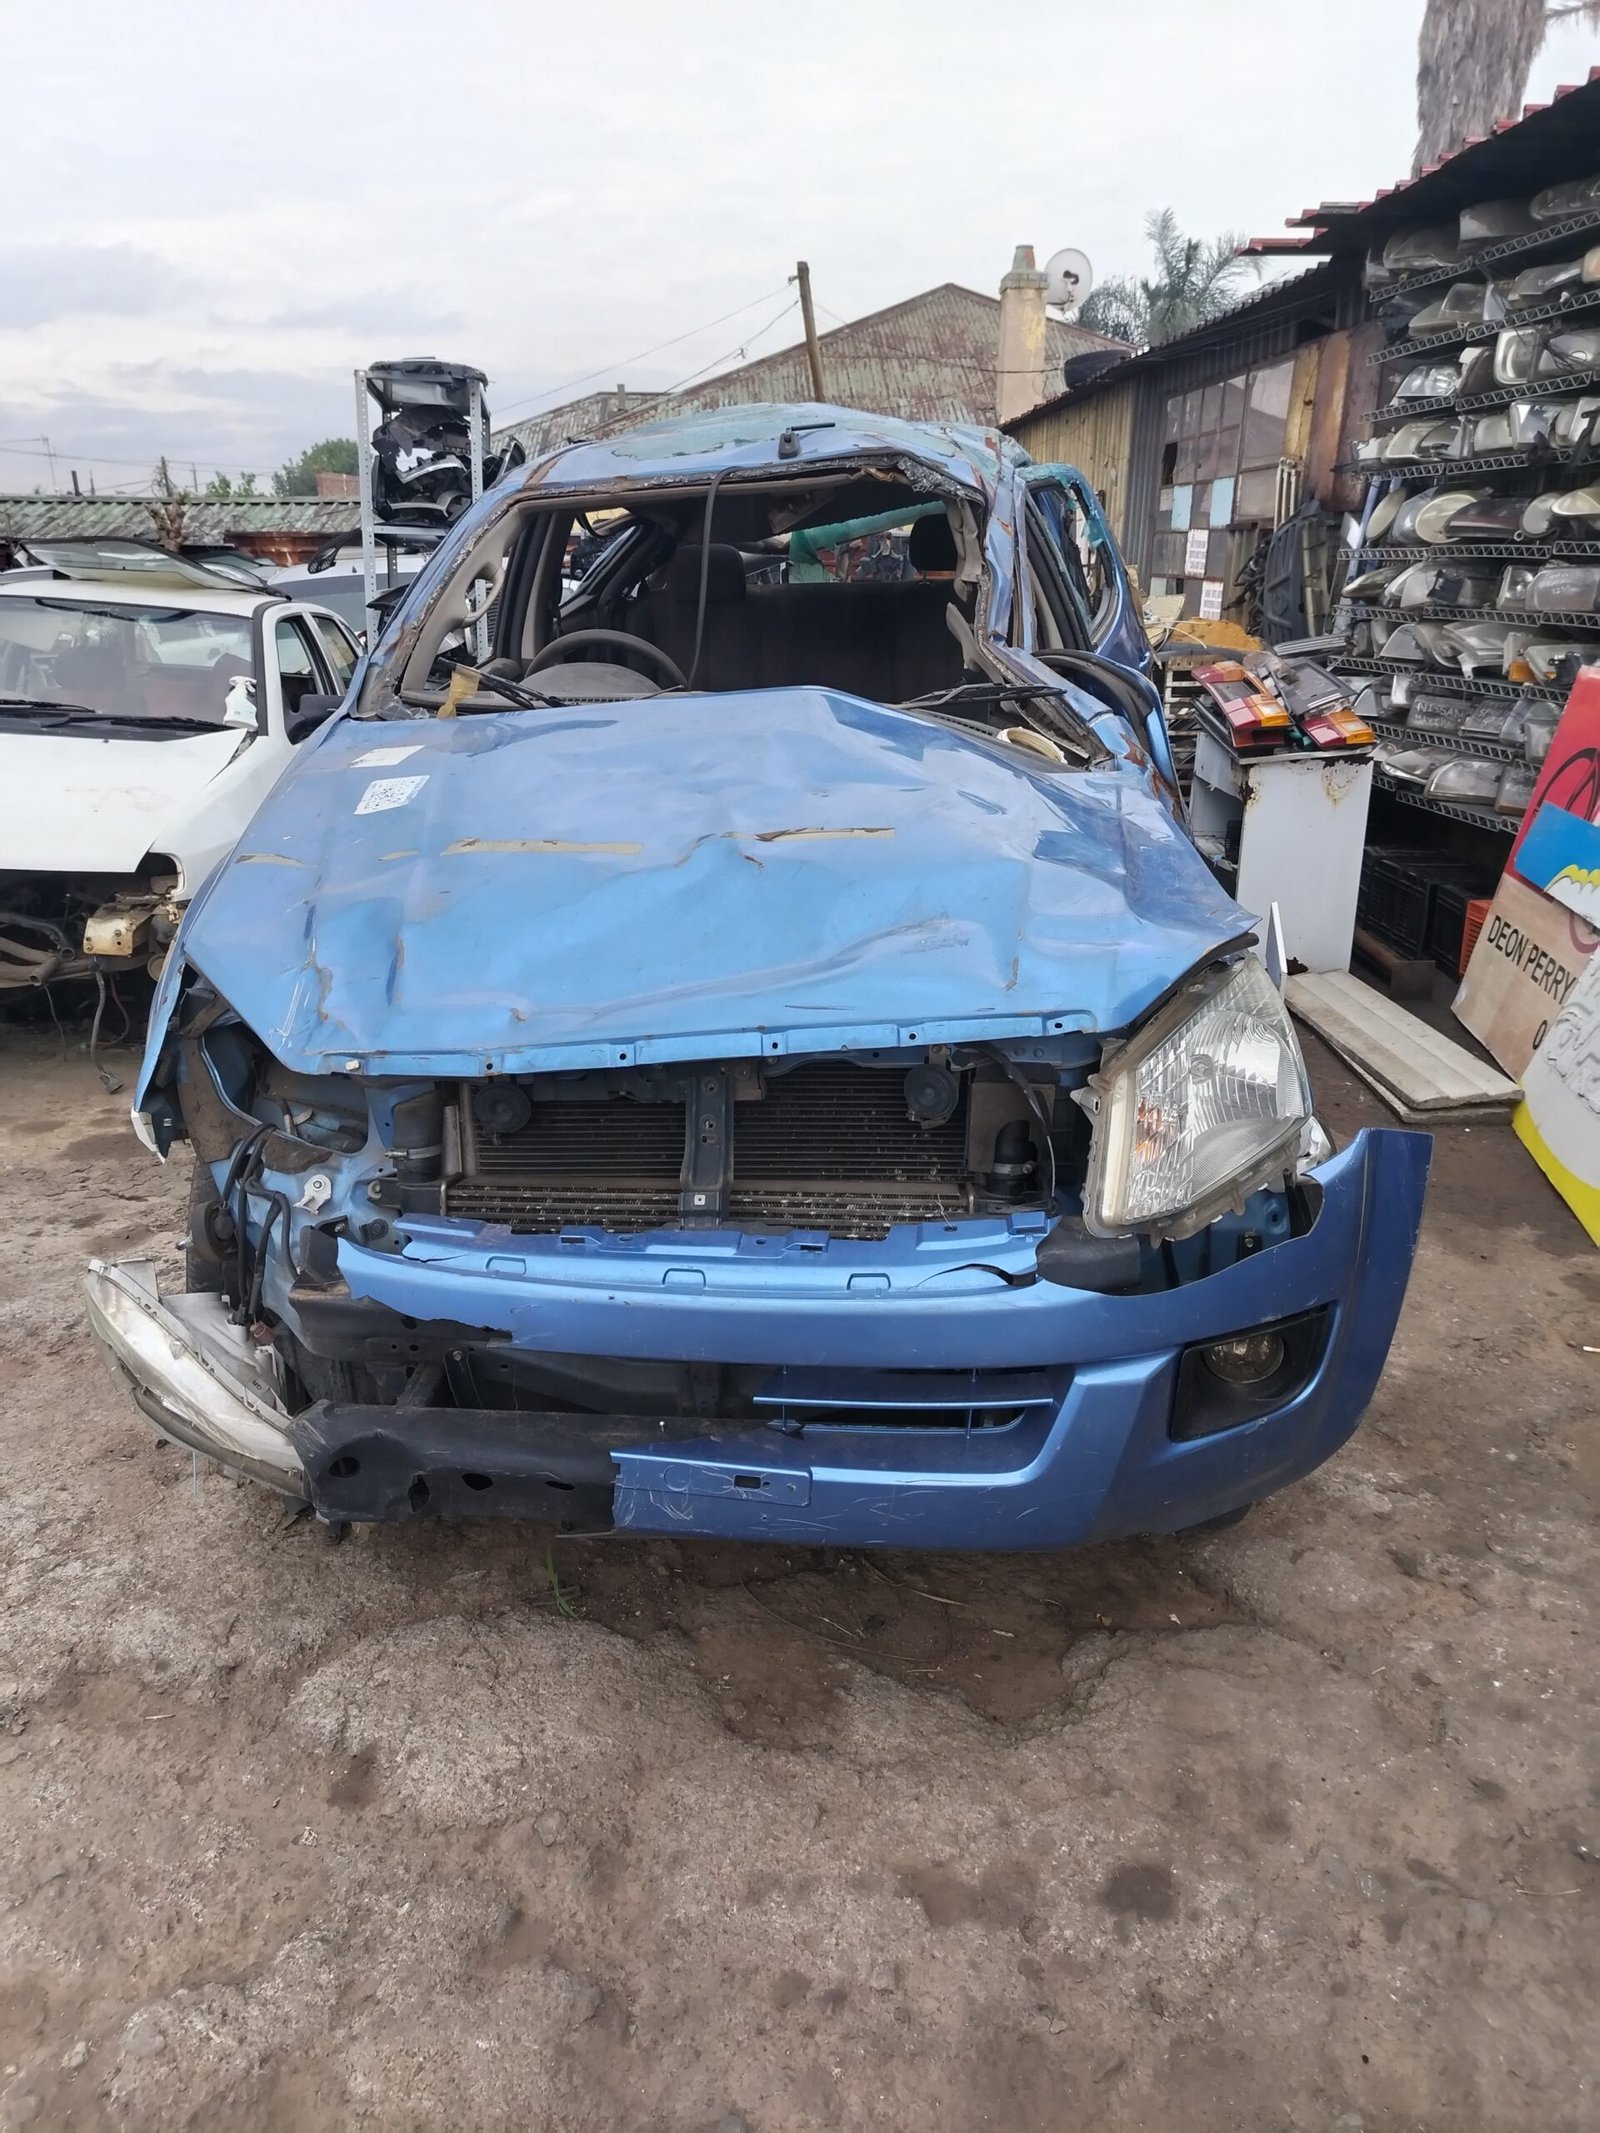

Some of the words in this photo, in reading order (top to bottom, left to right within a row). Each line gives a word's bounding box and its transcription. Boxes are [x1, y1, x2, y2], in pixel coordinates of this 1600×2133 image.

[1416, 702, 1463, 718] NISSAN
[1487, 915, 1528, 967] DEON
[1522, 943, 1577, 1005] PERRY
